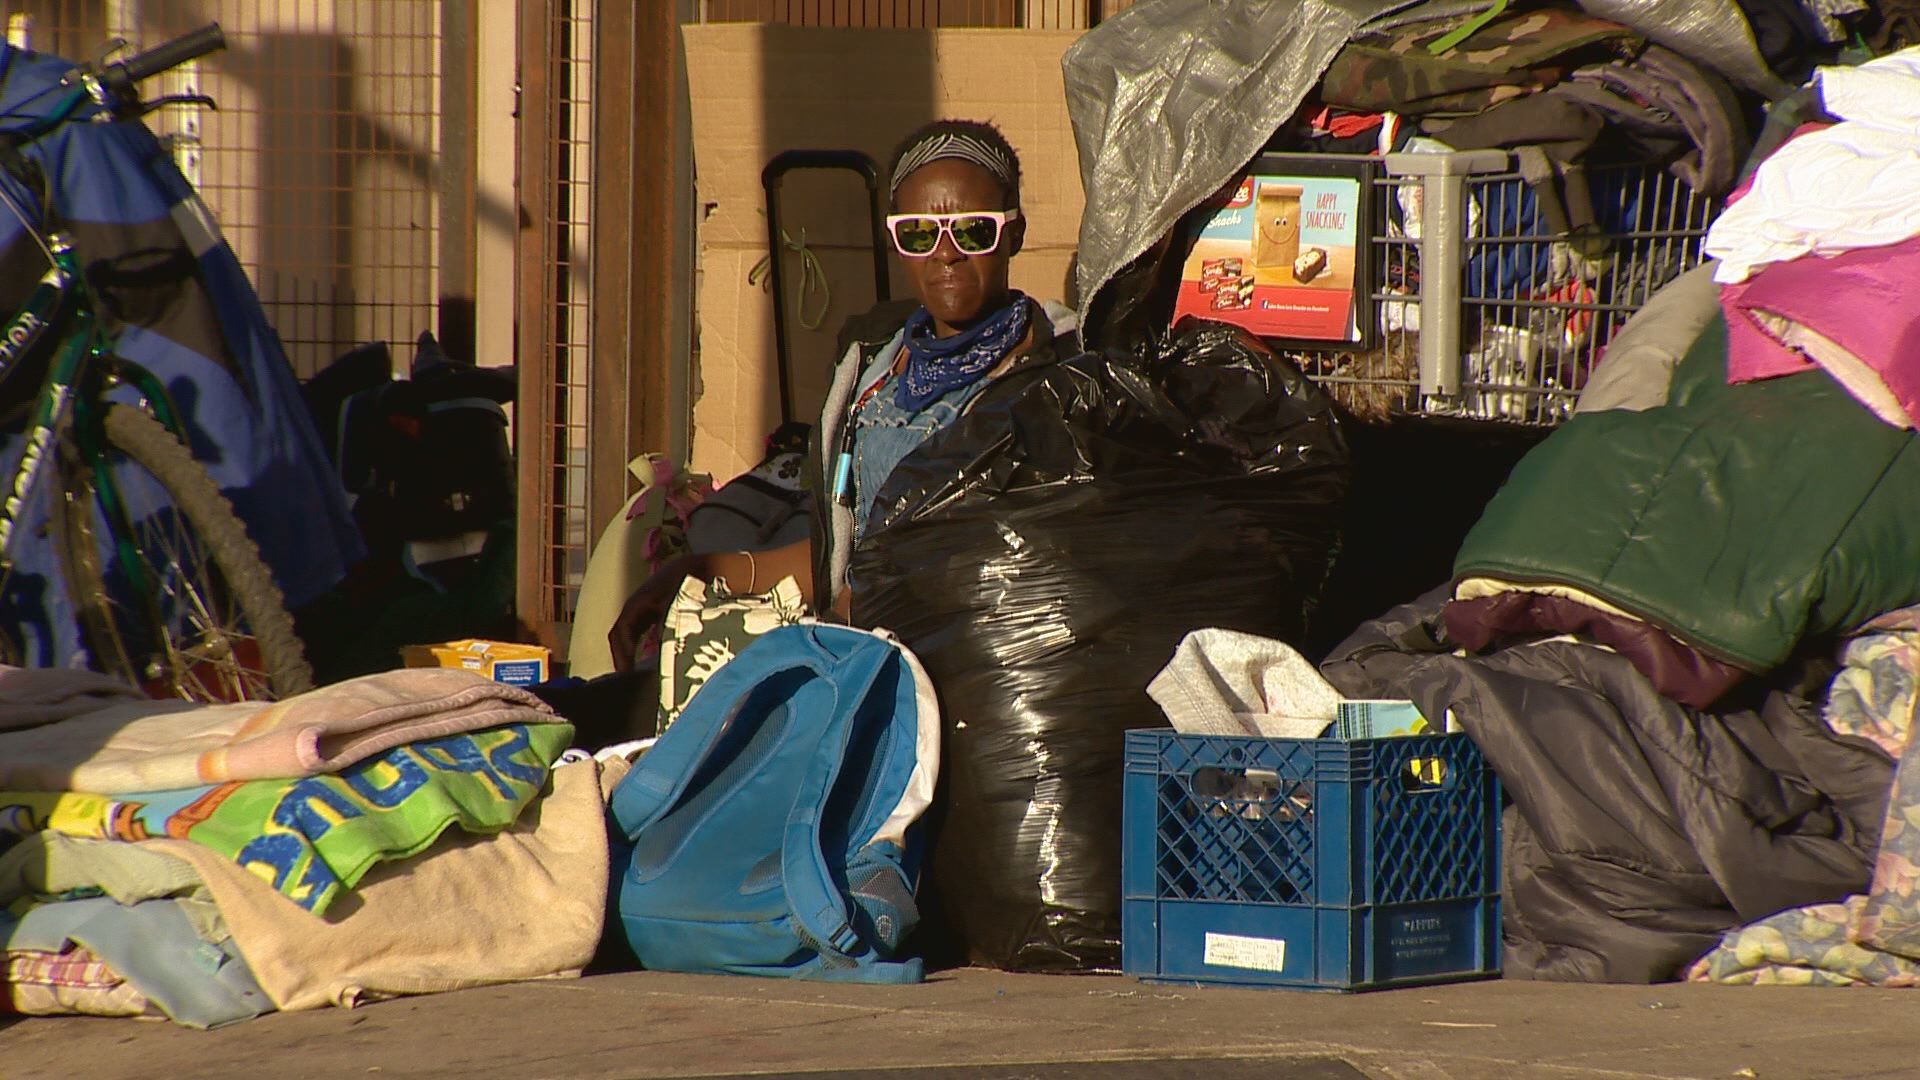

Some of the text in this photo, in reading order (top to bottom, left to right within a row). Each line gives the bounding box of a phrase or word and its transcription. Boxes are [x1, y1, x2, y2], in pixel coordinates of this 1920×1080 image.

[1316, 192, 1337, 210] HAPPY
[1207, 210, 1242, 228] Snacks
[1305, 212, 1346, 229] SNACKING!
[0, 311, 40, 367] TOR
